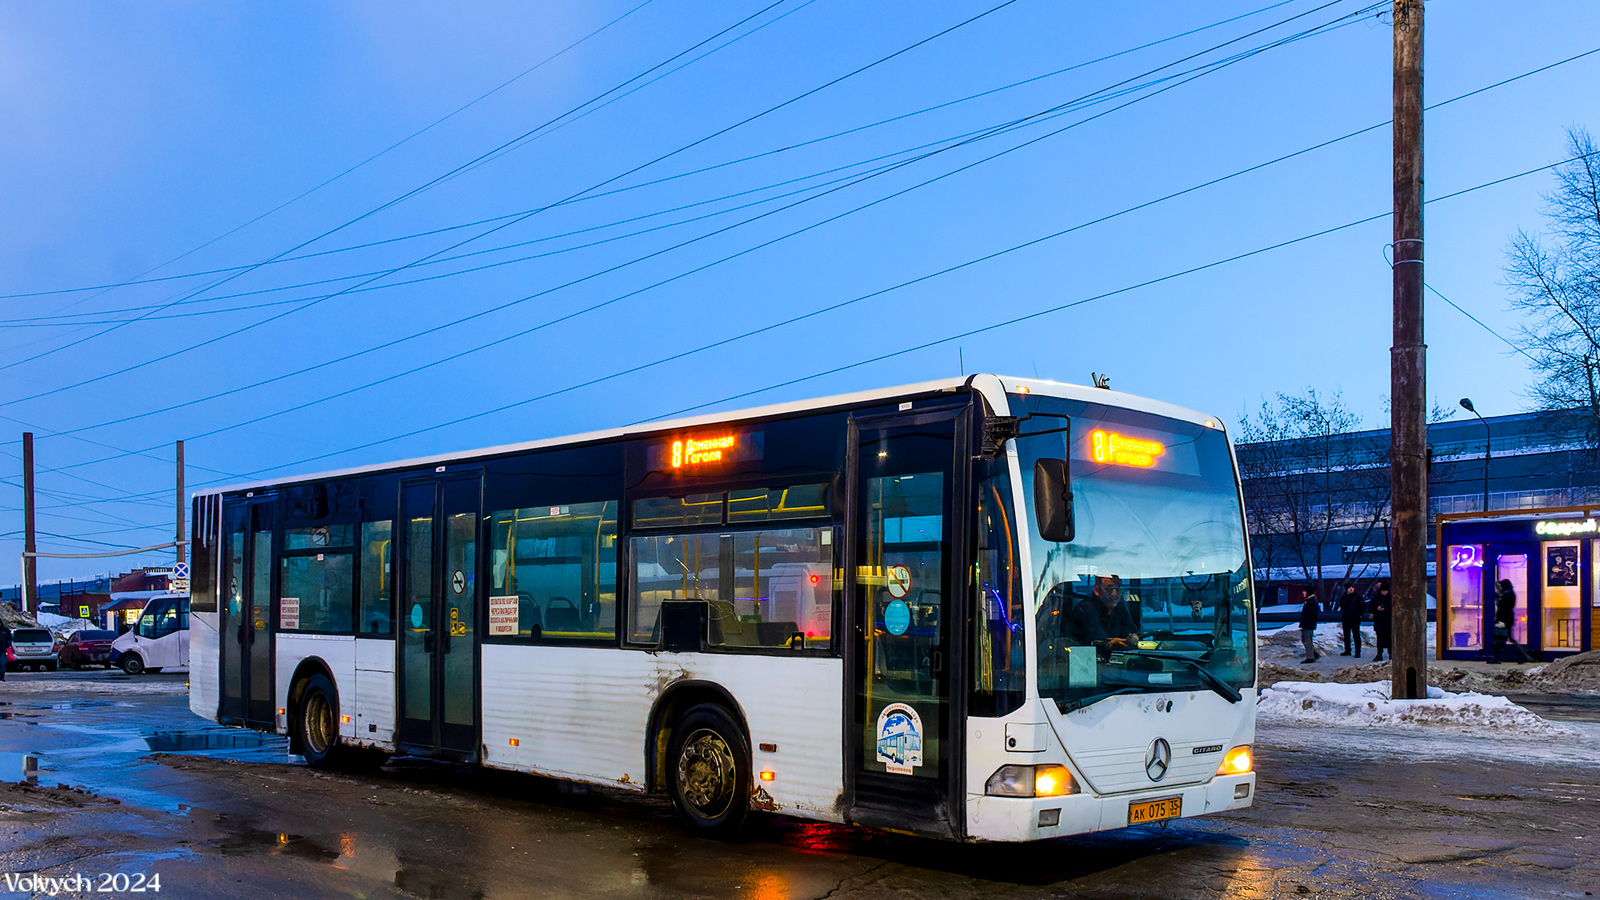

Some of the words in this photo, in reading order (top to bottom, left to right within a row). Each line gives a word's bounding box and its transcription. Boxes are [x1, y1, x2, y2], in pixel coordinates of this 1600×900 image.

[686, 436, 735, 455] Доменная
[1092, 430, 1106, 463] 8
[672, 441, 682, 468] 8
[684, 450, 721, 465] Гоголя
[1193, 745, 1222, 754] CITARO
[1149, 802, 1165, 818] 075
